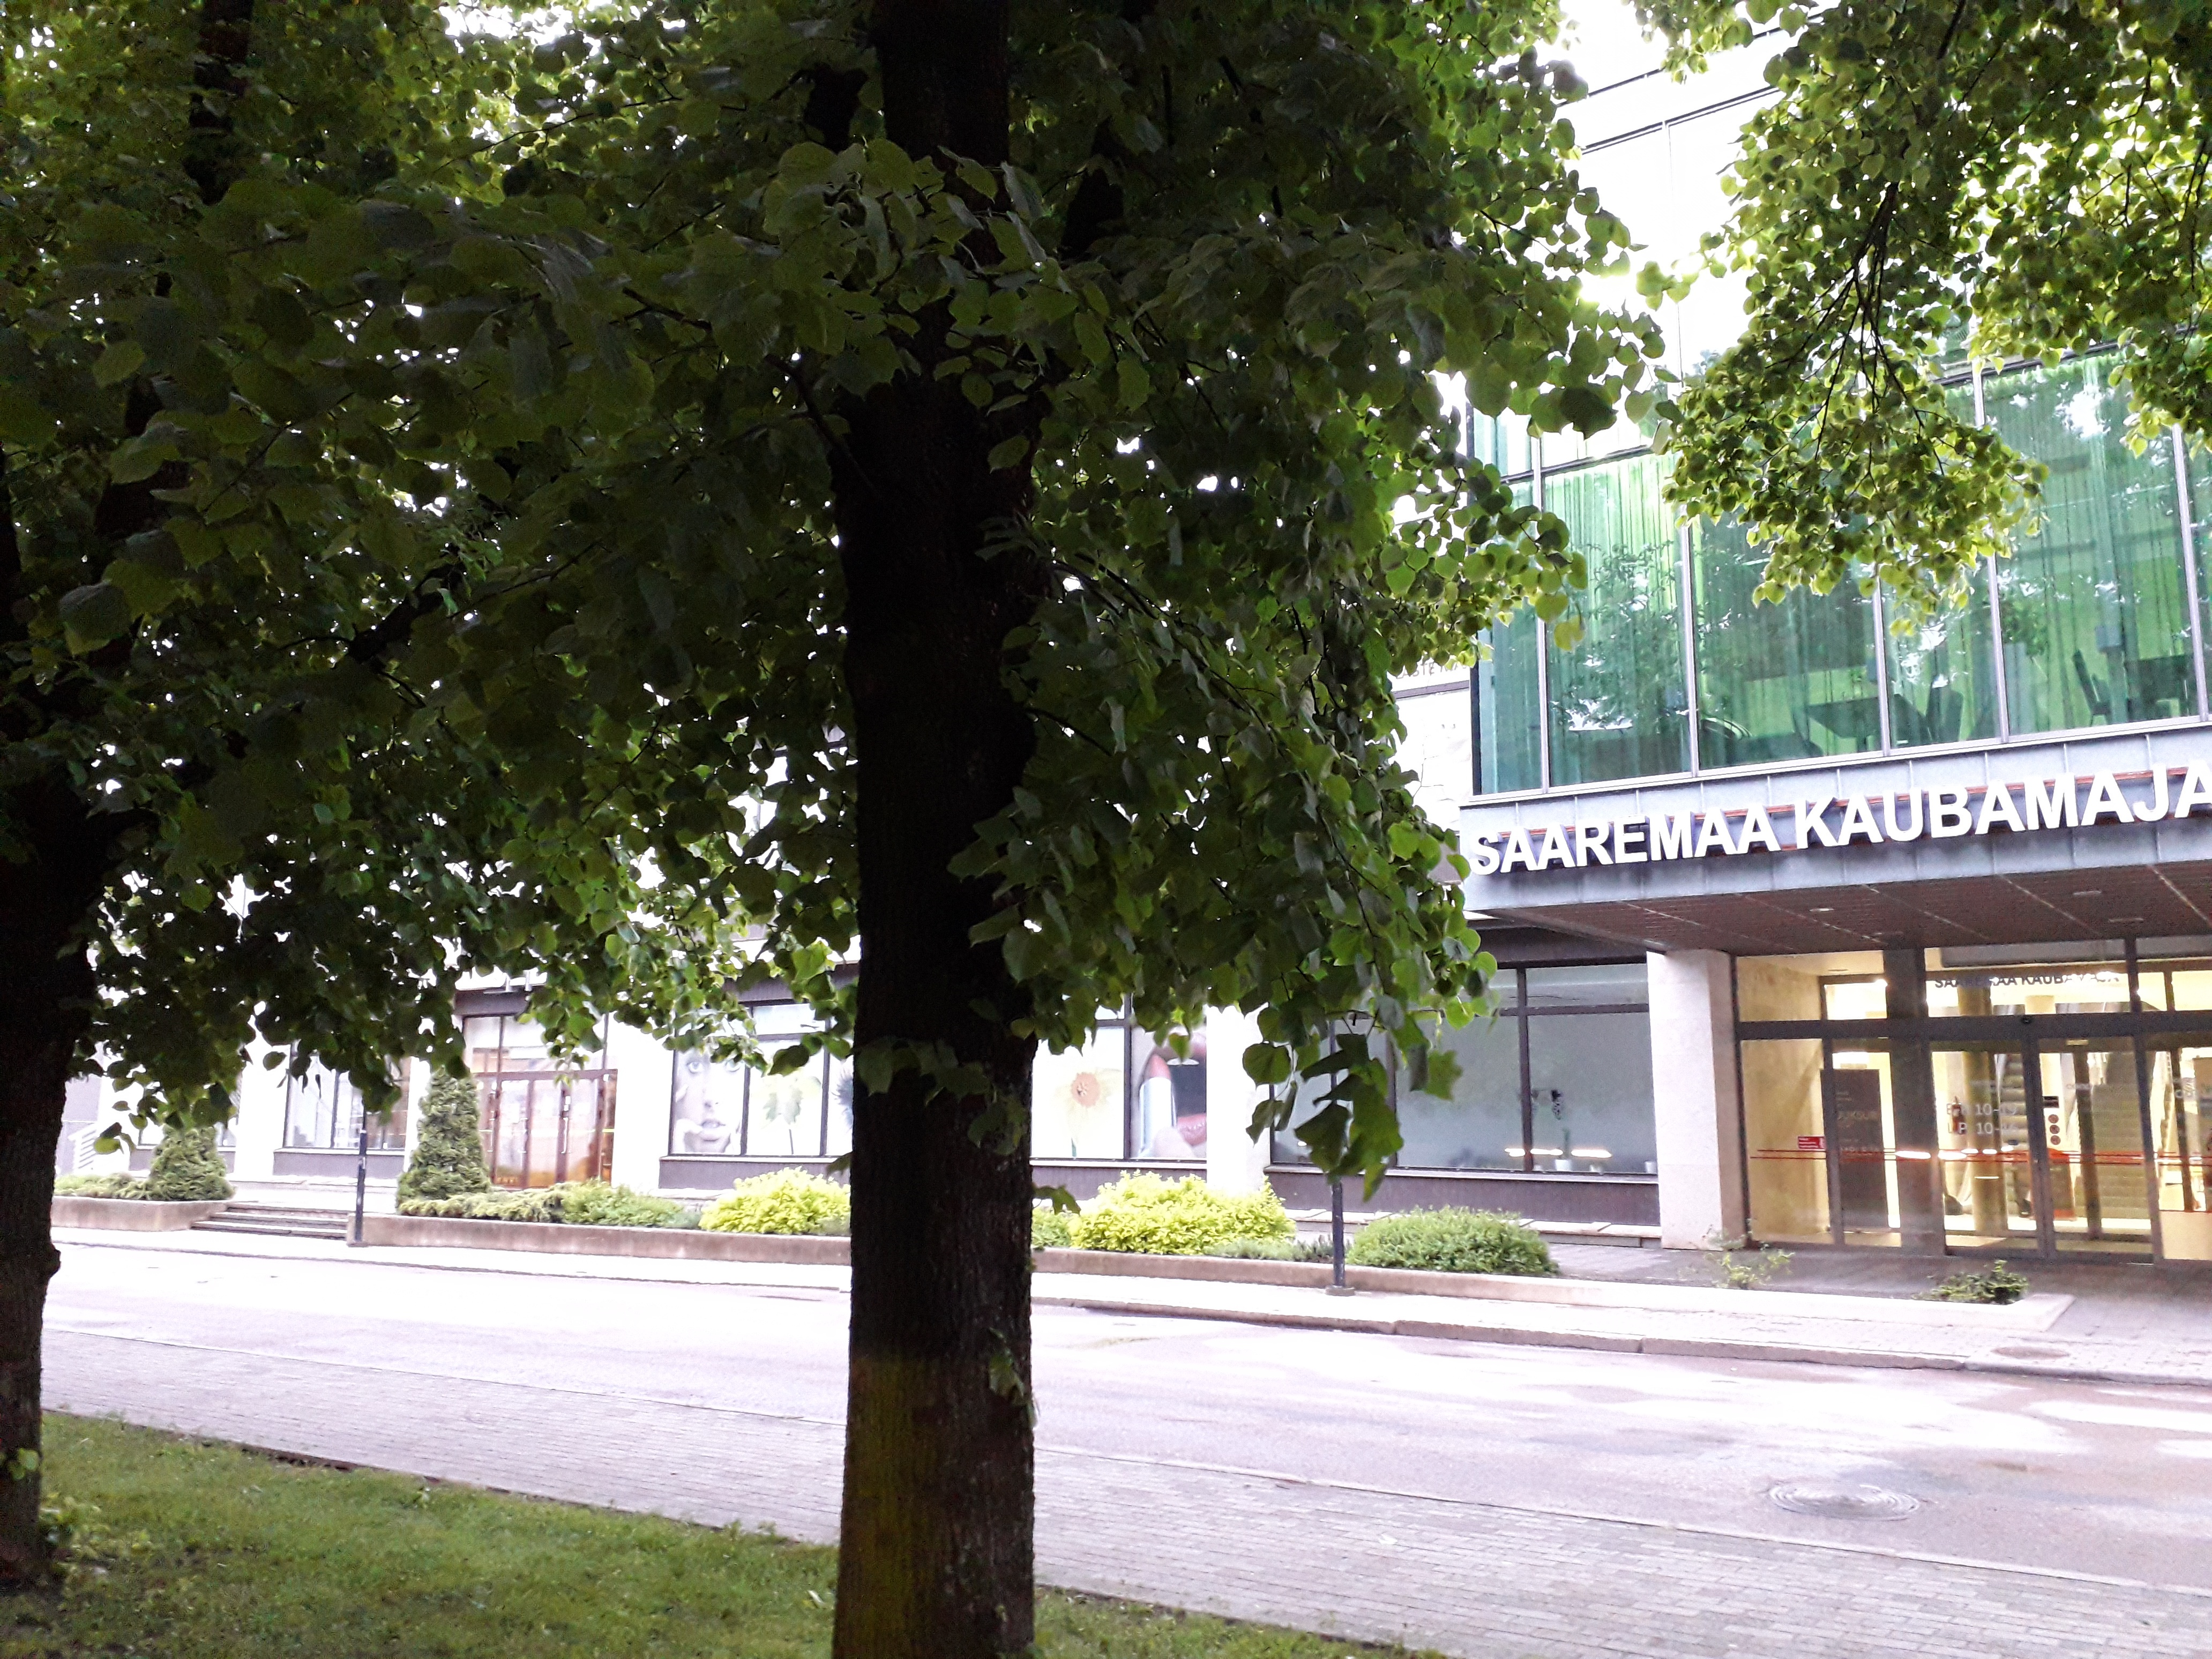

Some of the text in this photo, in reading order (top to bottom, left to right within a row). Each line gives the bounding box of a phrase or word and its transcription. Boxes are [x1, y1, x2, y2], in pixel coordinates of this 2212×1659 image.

[1468, 760, 2212, 876] SAAREMAA KAUBAMAJA
[1934, 977, 2018, 989] SAAEAA
